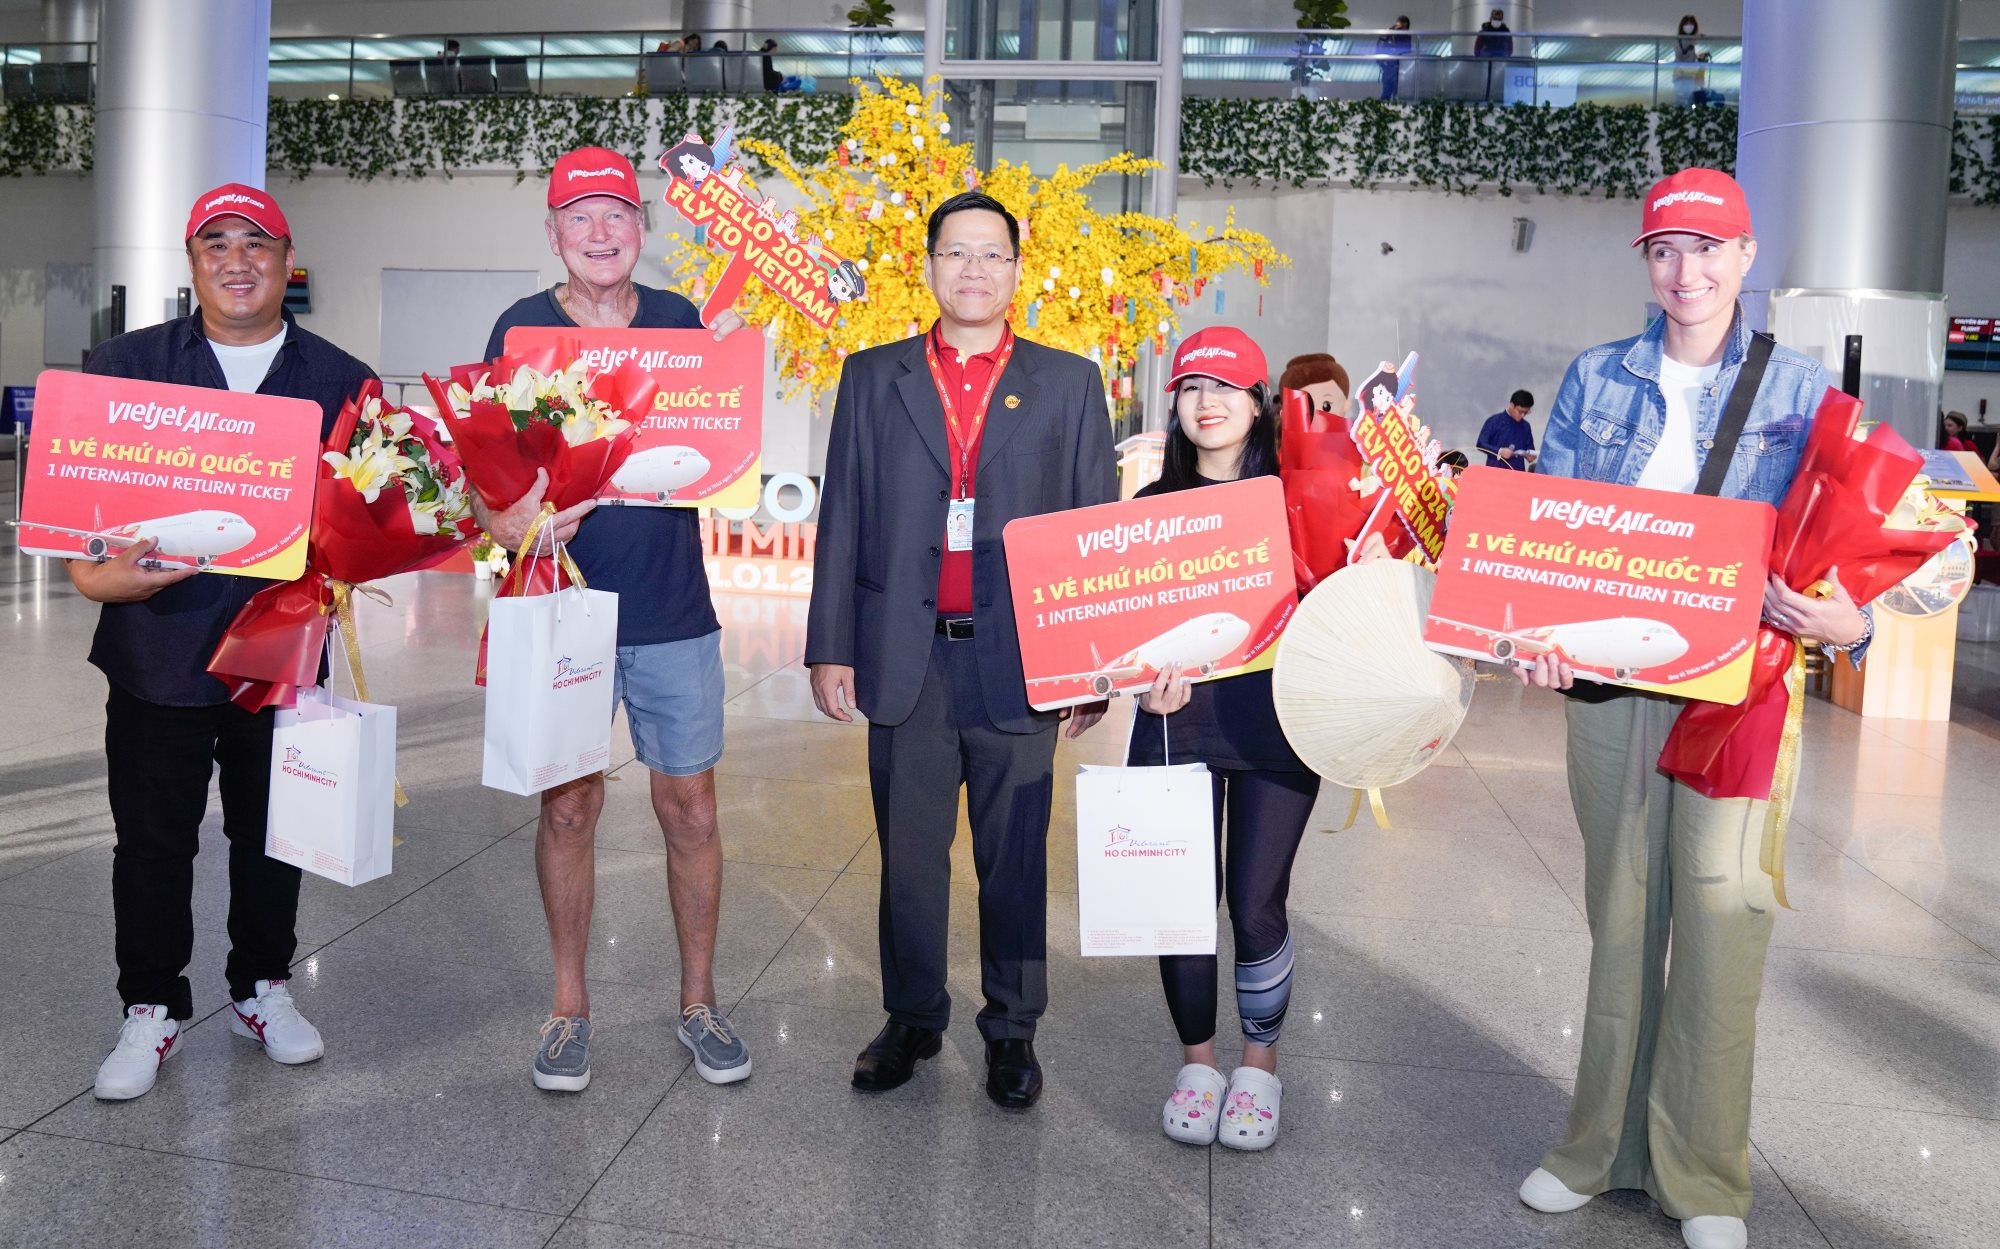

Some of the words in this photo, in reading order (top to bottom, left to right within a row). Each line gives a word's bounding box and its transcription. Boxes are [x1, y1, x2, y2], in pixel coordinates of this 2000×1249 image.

[670, 181, 715, 220] FLY
[711, 215, 742, 247] TO
[742, 240, 836, 324] VIETNAM
[701, 178, 773, 241] HELLO
[771, 237, 826, 289] 2024
[579, 346, 703, 374] ietjetAir.com
[653, 385, 713, 411] QUỐC
[716, 384, 745, 409] TẾ
[640, 415, 689, 430] ETURN
[691, 416, 742, 431] TICKET
[46, 463, 56, 477] 1
[60, 464, 169, 488] INTERNATION
[172, 476, 236, 496] RETURN
[239, 483, 292, 501] TICKET
[49, 438, 62, 454] 1
[68, 436, 98, 458] VÉ
[101, 441, 154, 464] KHỨ
[155, 445, 197, 469] HỒI
[200, 451, 264, 476] QUỐC
[267, 455, 297, 479] TẾ
[1380, 409, 1421, 476] HELLO
[1415, 470, 1447, 522] 2024
[1357, 414, 1387, 457] FLY
[1379, 451, 1399, 483] TO
[1393, 474, 1445, 559] VIETNAM
[1032, 587, 1045, 605] 1
[1049, 577, 1079, 601] VÉ
[1083, 566, 1130, 595] KHỨ
[1135, 556, 1174, 584] HỒI
[1178, 545, 1240, 581] QUỐC
[1243, 537, 1270, 566] TẾ
[1465, 532, 1479, 549] 1
[1485, 533, 1517, 555] VÉ
[1519, 540, 1576, 564] KHỨ
[1577, 546, 1623, 572] HỒI
[1626, 555, 1702, 584] QUỐC
[1706, 562, 1745, 588] TẾ
[1036, 613, 1046, 628] 1
[1049, 595, 1153, 625] INTERNATION
[1157, 582, 1219, 605] RETURN
[1222, 571, 1274, 593] TICKET
[1460, 558, 1470, 572] 1
[1473, 559, 1591, 592] INTERNATION
[1593, 577, 1668, 603] RETURN
[1672, 590, 1737, 613] TICKET
[553, 680, 563, 690] HO
[563, 678, 574, 688] CHI
[574, 674, 589, 685] MINH
[589, 669, 603, 681] CITY
[282, 765, 292, 774] HO
[292, 768, 304, 778] CHI
[304, 772, 321, 784] MINH
[321, 777, 337, 789] CITY
[1104, 849, 1120, 857] HO
[1121, 849, 1138, 857] CHI
[1138, 849, 1163, 857] MINH
[1164, 848, 1187, 857] CITY
